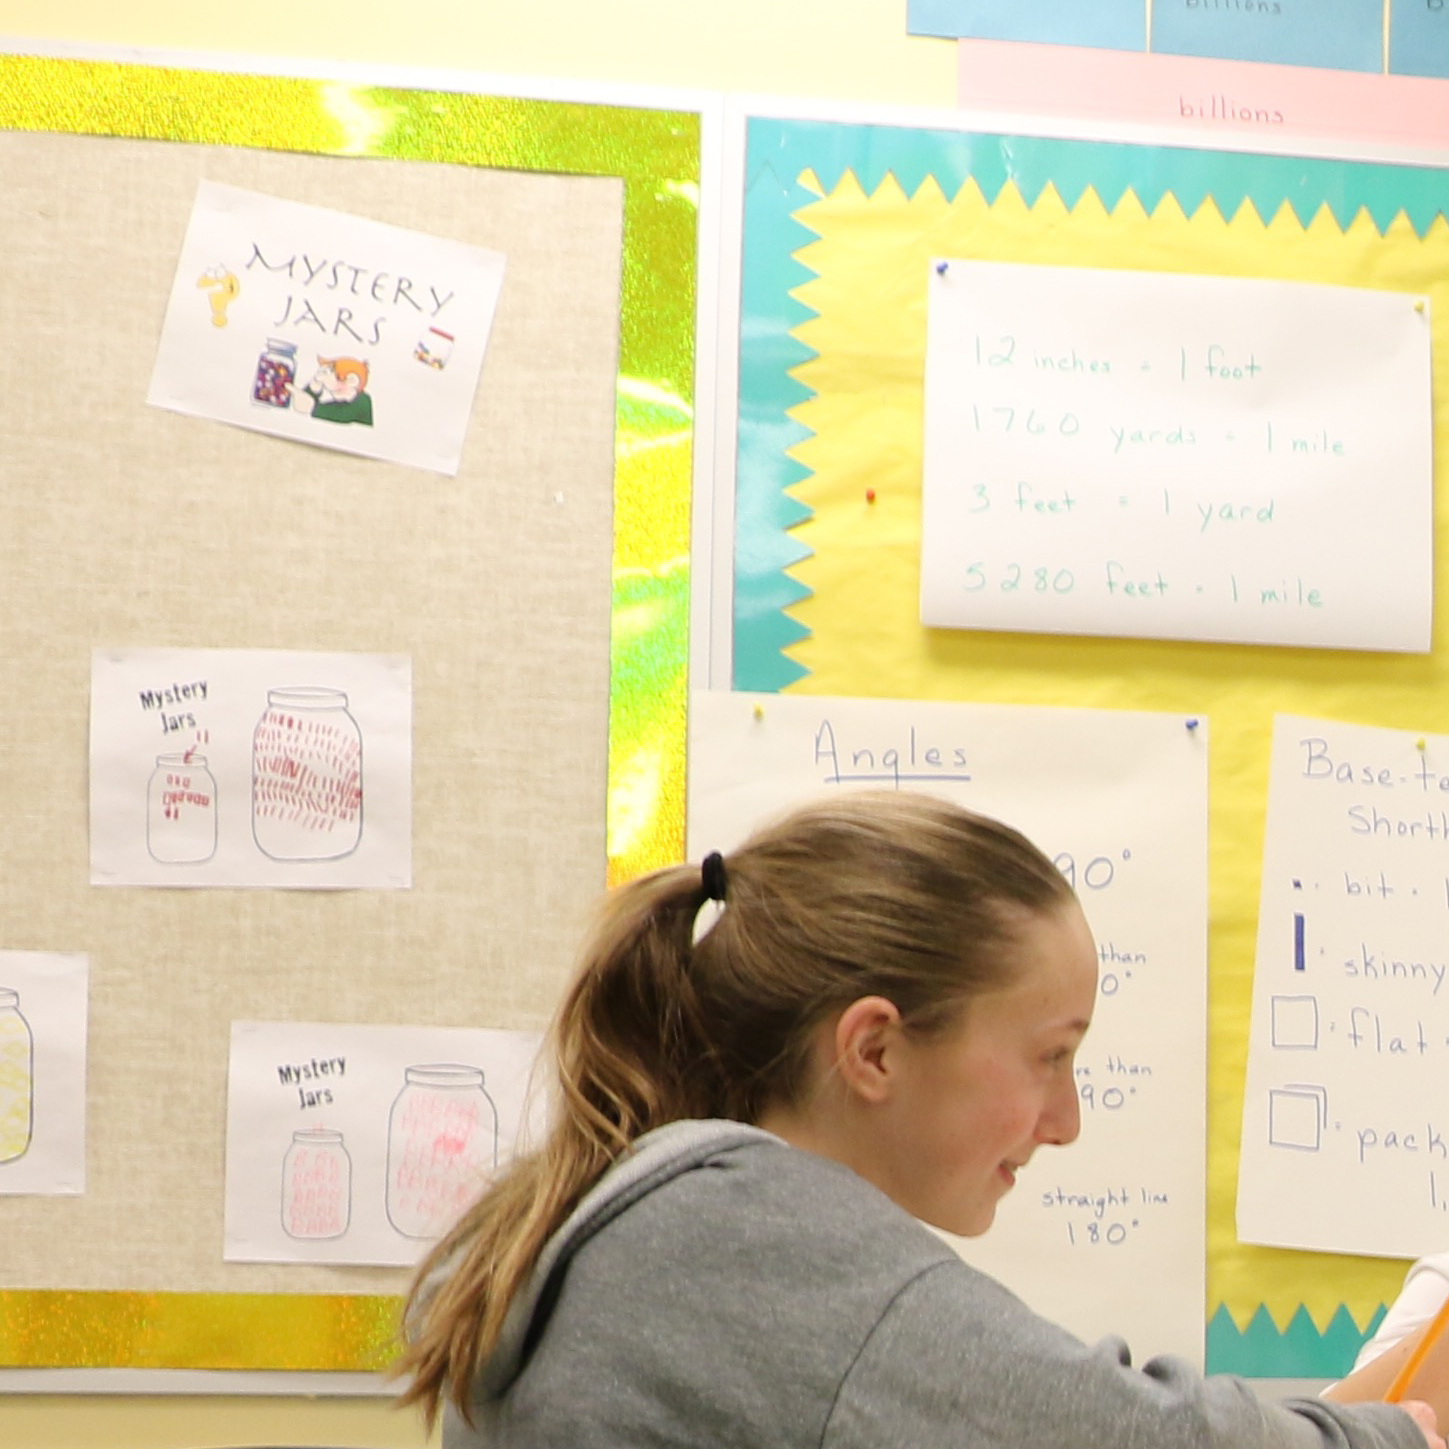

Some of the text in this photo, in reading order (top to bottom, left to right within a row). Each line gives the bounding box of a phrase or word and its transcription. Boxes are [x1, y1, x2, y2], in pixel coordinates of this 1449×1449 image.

[1179, 95, 1285, 124] billions
[246, 241, 454, 317] MYSTERY
[274, 296, 387, 346] JARS
[974, 335, 1016, 367] 12
[1034, 351, 1112, 375] inches
[1180, 346, 1186, 381] 1
[1203, 346, 1262, 380] foot
[1110, 425, 1196, 454] yards
[1291, 432, 1345, 456] mile
[970, 482, 991, 513] 3
[1014, 483, 1077, 514] feet
[1197, 498, 1276, 533] yard
[963, 561, 1075, 595] 5280
[1106, 562, 1169, 596] feet
[1260, 573, 1324, 608] mile
[138, 680, 208, 711] Mystery
[161, 711, 197, 735] Jars
[813, 719, 968, 790] Angles
[1345, 871, 1394, 899] bit
[1099, 942, 1146, 964] than
[1344, 942, 1446, 995] skinny
[1348, 1006, 1428, 1055] flat
[278, 1057, 346, 1086] Mystery
[1106, 1055, 1152, 1075] than
[299, 1087, 334, 1111] Jars
[1357, 1124, 1448, 1164] pack
[1042, 1186, 1168, 1218] straight line
